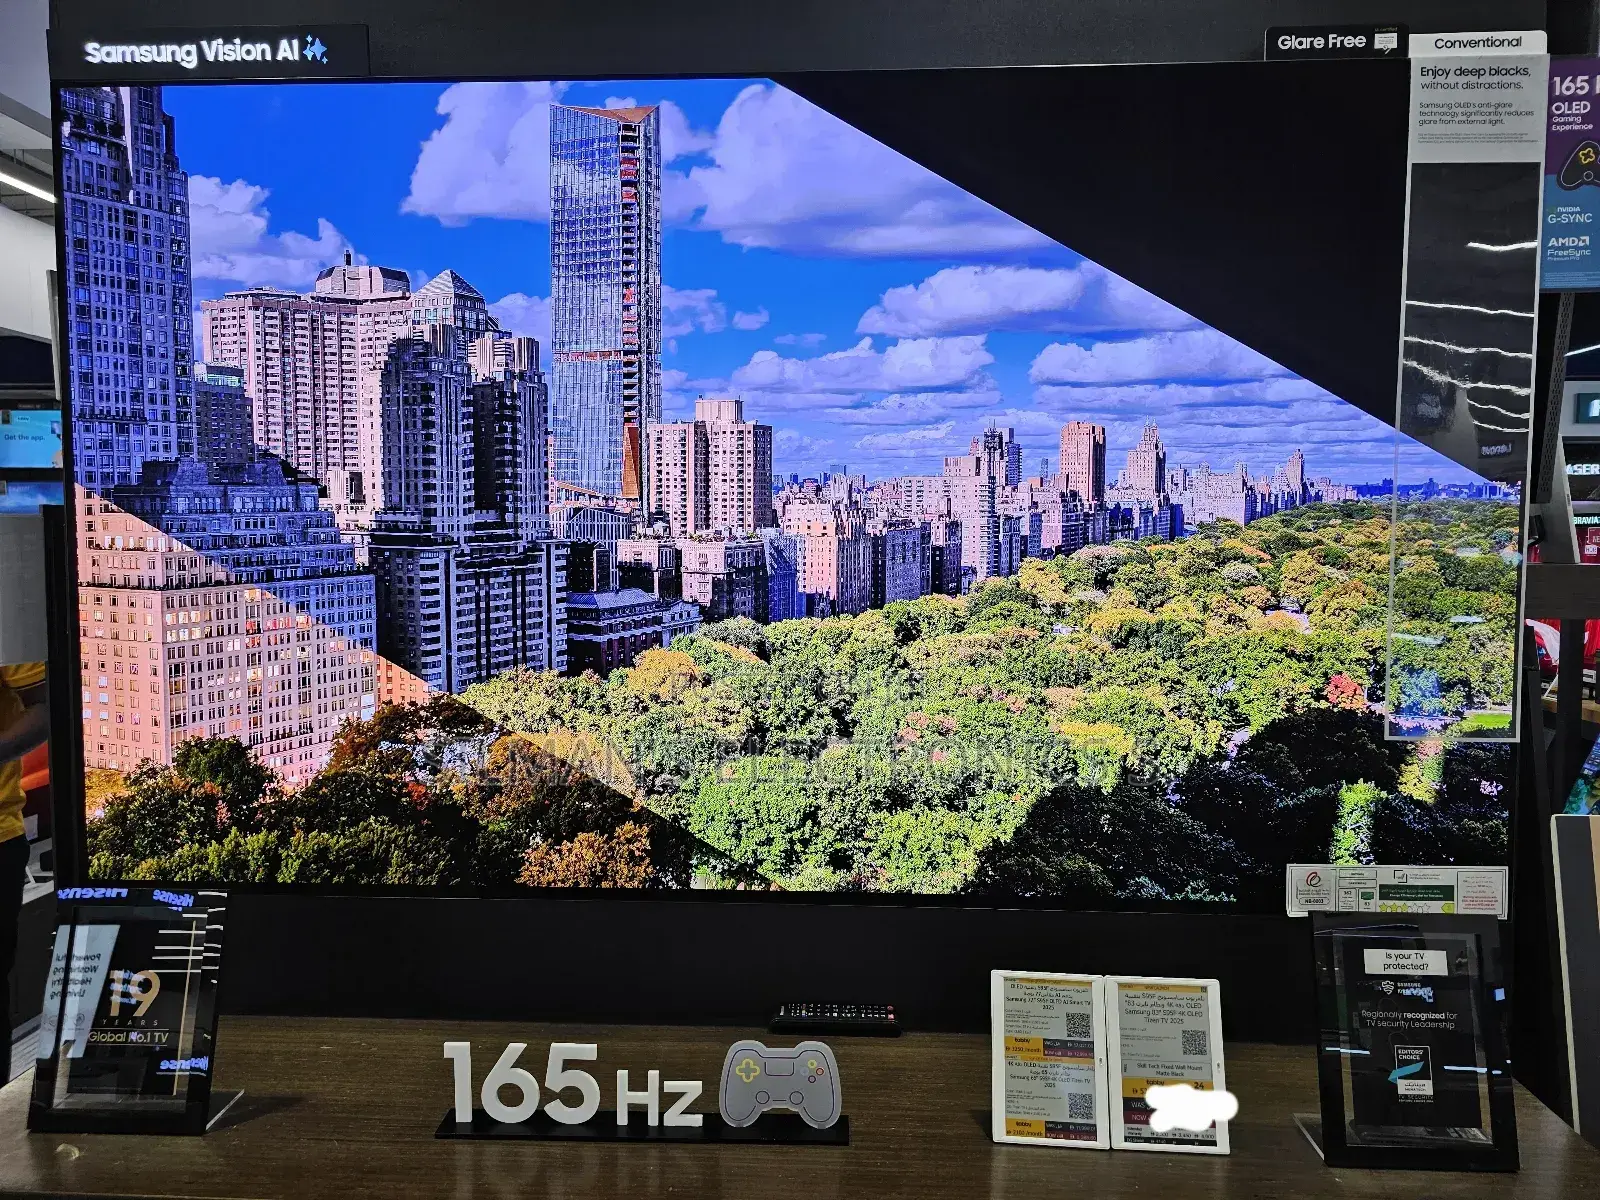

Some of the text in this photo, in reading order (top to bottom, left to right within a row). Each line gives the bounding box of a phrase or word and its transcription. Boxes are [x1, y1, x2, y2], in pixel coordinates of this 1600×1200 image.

[1277, 34, 1367, 50] Glare Free
[1434, 36, 1523, 49] Conventional
[83, 38, 300, 69] Samsung Vision AI
[1420, 66, 1531, 79] Enjoy deep blacks,
[1420, 80, 1524, 90] without distractions.
[1553, 75, 1590, 96] 165
[1419, 102, 1453, 110] Samsung
[1477, 101, 1513, 109] anti-glare
[1552, 101, 1591, 115] OLED
[1419, 110, 1459, 119] technology
[1460, 110, 1503, 118] significantly
[1488, 118, 1505, 126] light.
[1552, 124, 1594, 132] Experience
[1547, 213, 1593, 224] G-SYNC
[1547, 237, 1579, 247] AMD
[1547, 248, 1591, 257] FreeSync
[1394, 953, 1412, 961] your
[1383, 963, 1429, 971] protected?
[109, 969, 161, 1017] 19
[1124, 1008, 1151, 1016] Samsung
[1361, 1010, 1401, 1020] Regionally
[1403, 1011, 1445, 1021] recognized
[1377, 1020, 1410, 1029] security
[1410, 1022, 1455, 1031] Leadership
[88, 1031, 169, 1043] Global No.1 TV
[443, 1041, 703, 1127] 165 Hz
[1194, 1081, 1204, 1090] 24
